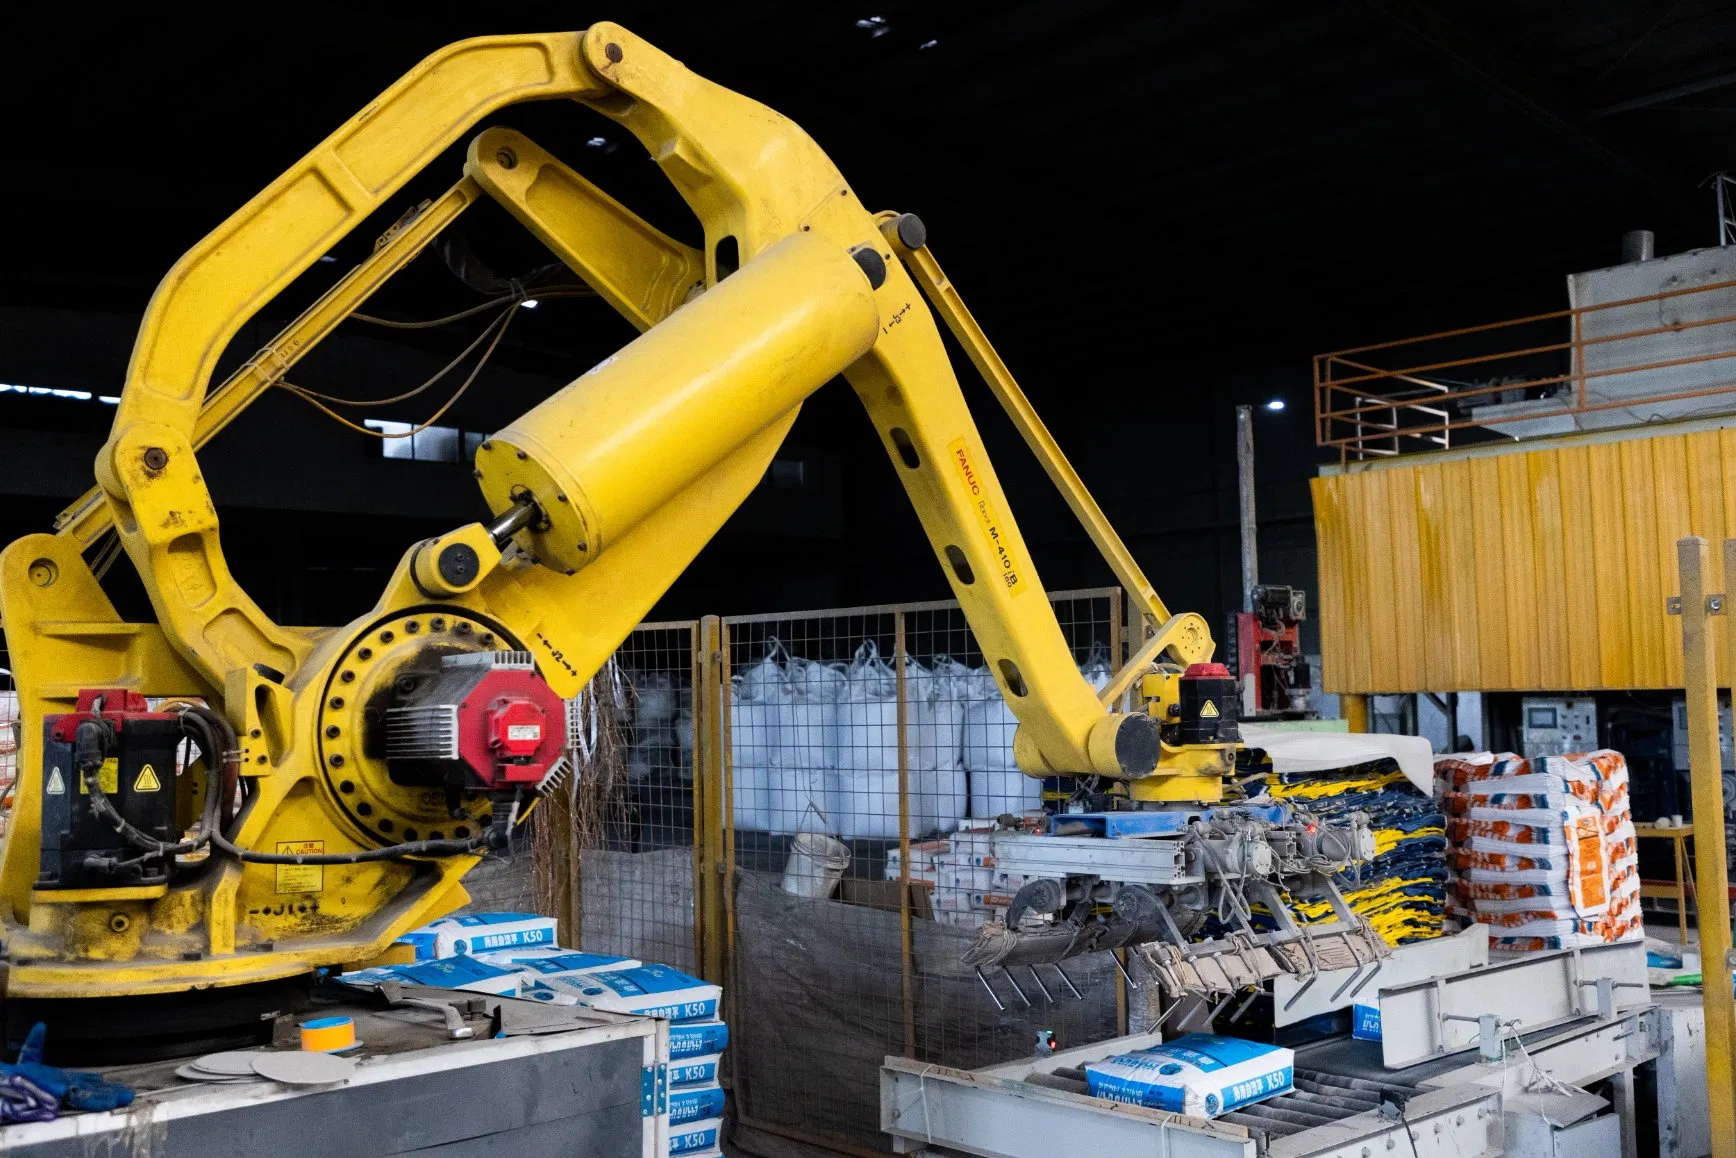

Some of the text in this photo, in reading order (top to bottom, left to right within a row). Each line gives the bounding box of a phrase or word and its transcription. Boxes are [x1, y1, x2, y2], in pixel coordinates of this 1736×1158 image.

[956, 449, 980, 496] FANUC
[523, 930, 543, 944] K50
[685, 1002, 706, 1017] K50
[685, 1065, 706, 1081] K50
[1266, 1071, 1285, 1091] K50
[684, 1132, 705, 1149] K50
